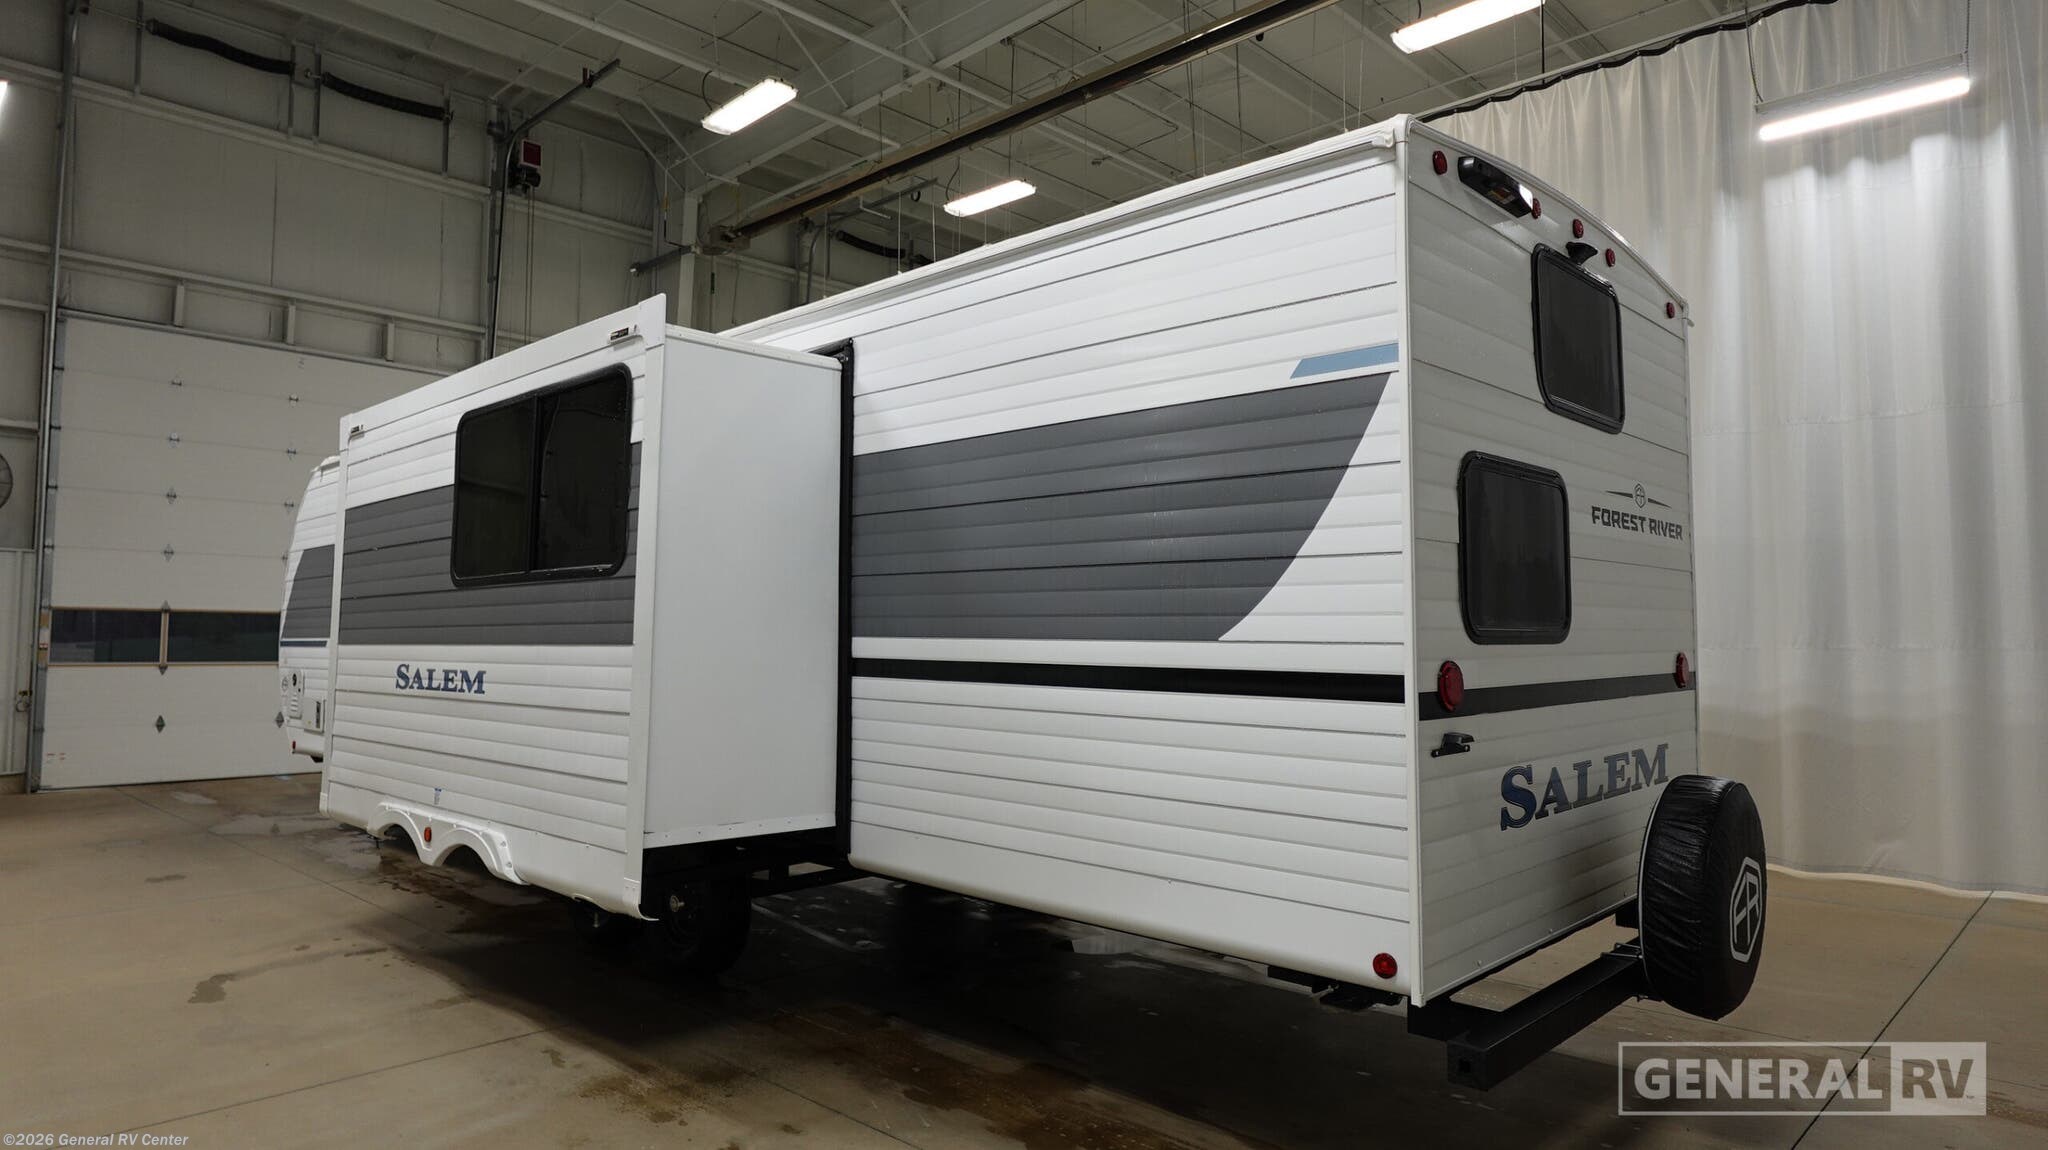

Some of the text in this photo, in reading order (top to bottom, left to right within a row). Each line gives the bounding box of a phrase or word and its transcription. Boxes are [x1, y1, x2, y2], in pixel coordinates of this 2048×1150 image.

[1591, 505, 1683, 541] FOREST RIVER
[395, 663, 487, 695] SALEM
[1500, 742, 1669, 831] SALEM
